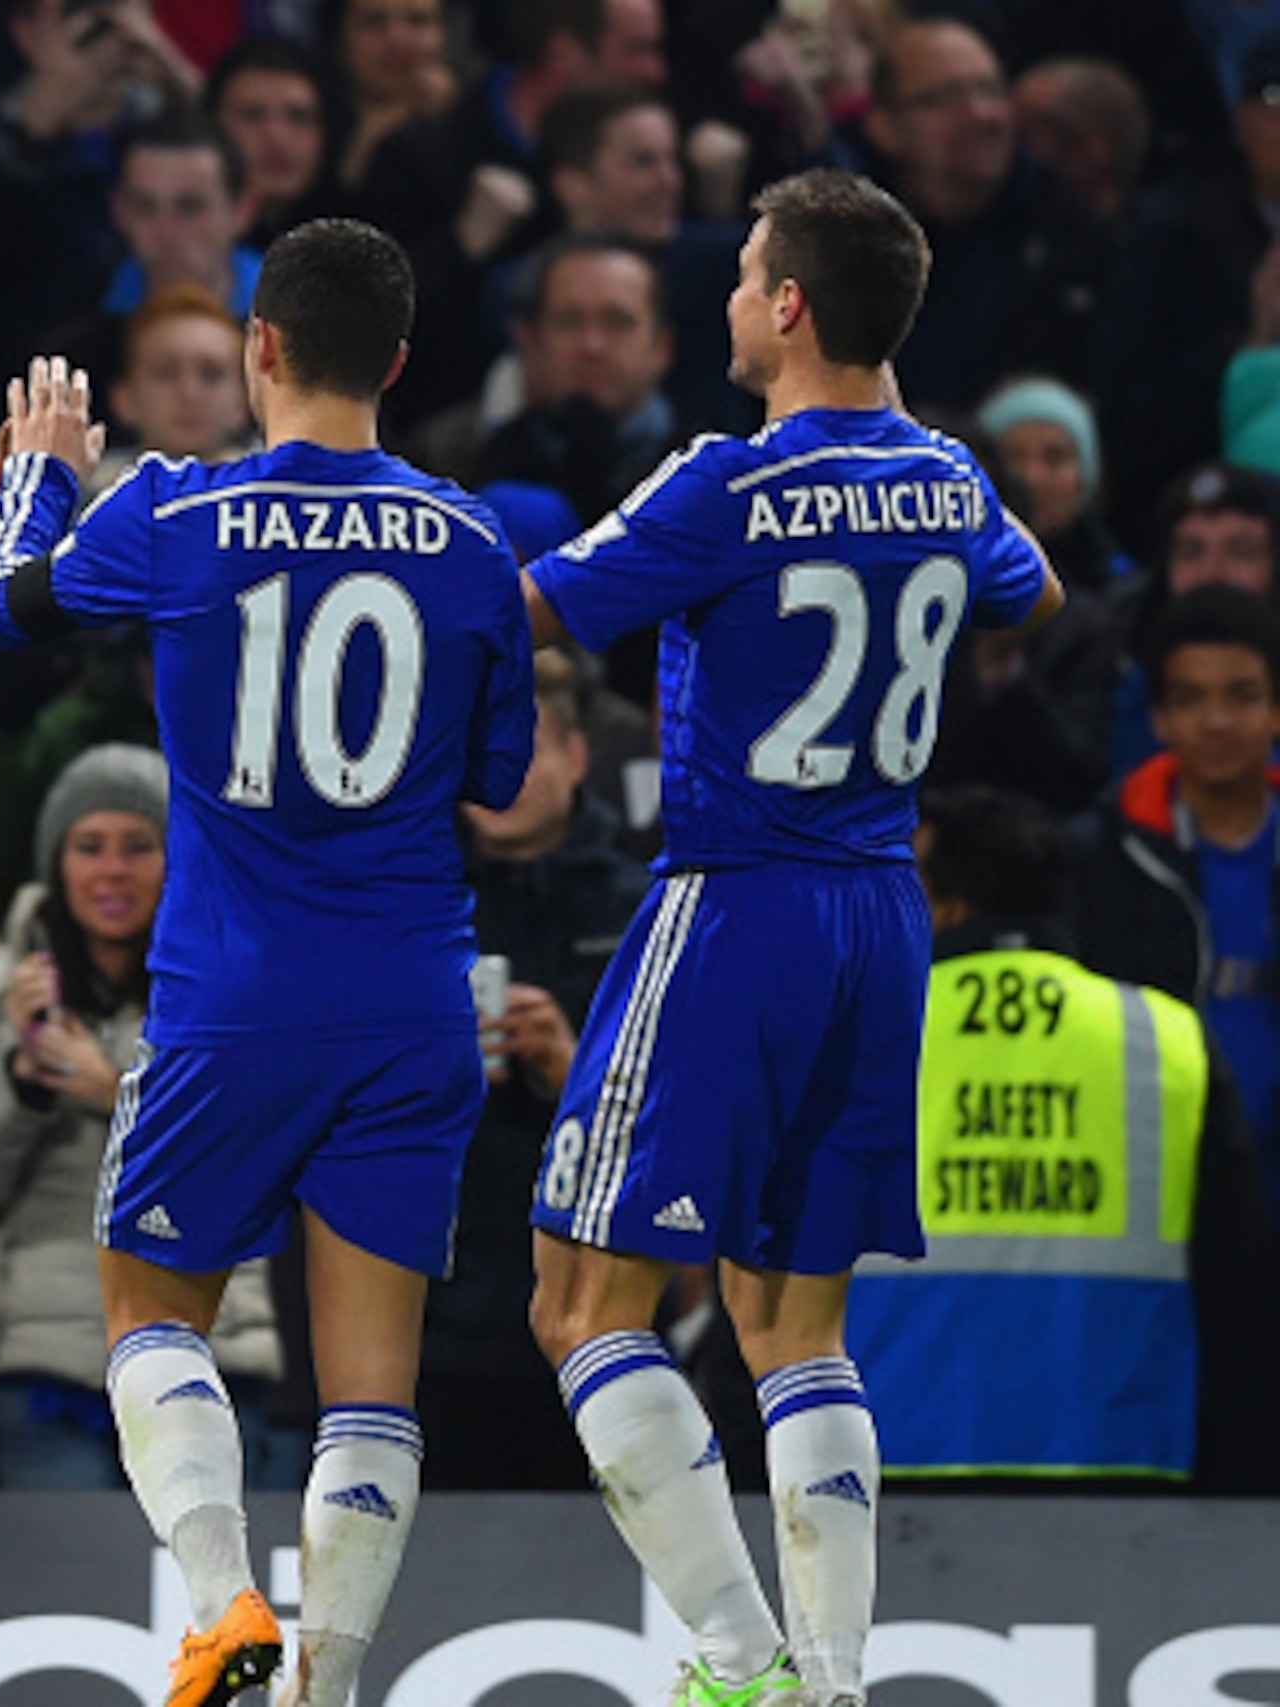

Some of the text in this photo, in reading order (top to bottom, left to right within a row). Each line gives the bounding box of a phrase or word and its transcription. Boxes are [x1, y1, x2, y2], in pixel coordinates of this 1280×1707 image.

[217, 501, 450, 554] HAZARD
[222, 571, 426, 809] 10
[747, 555, 969, 788] 28
[956, 968, 1066, 1037] 289
[956, 1081, 1081, 1139] SAFETY
[542, 1116, 586, 1210] 8
[936, 1157, 1102, 1216] STEWARD
